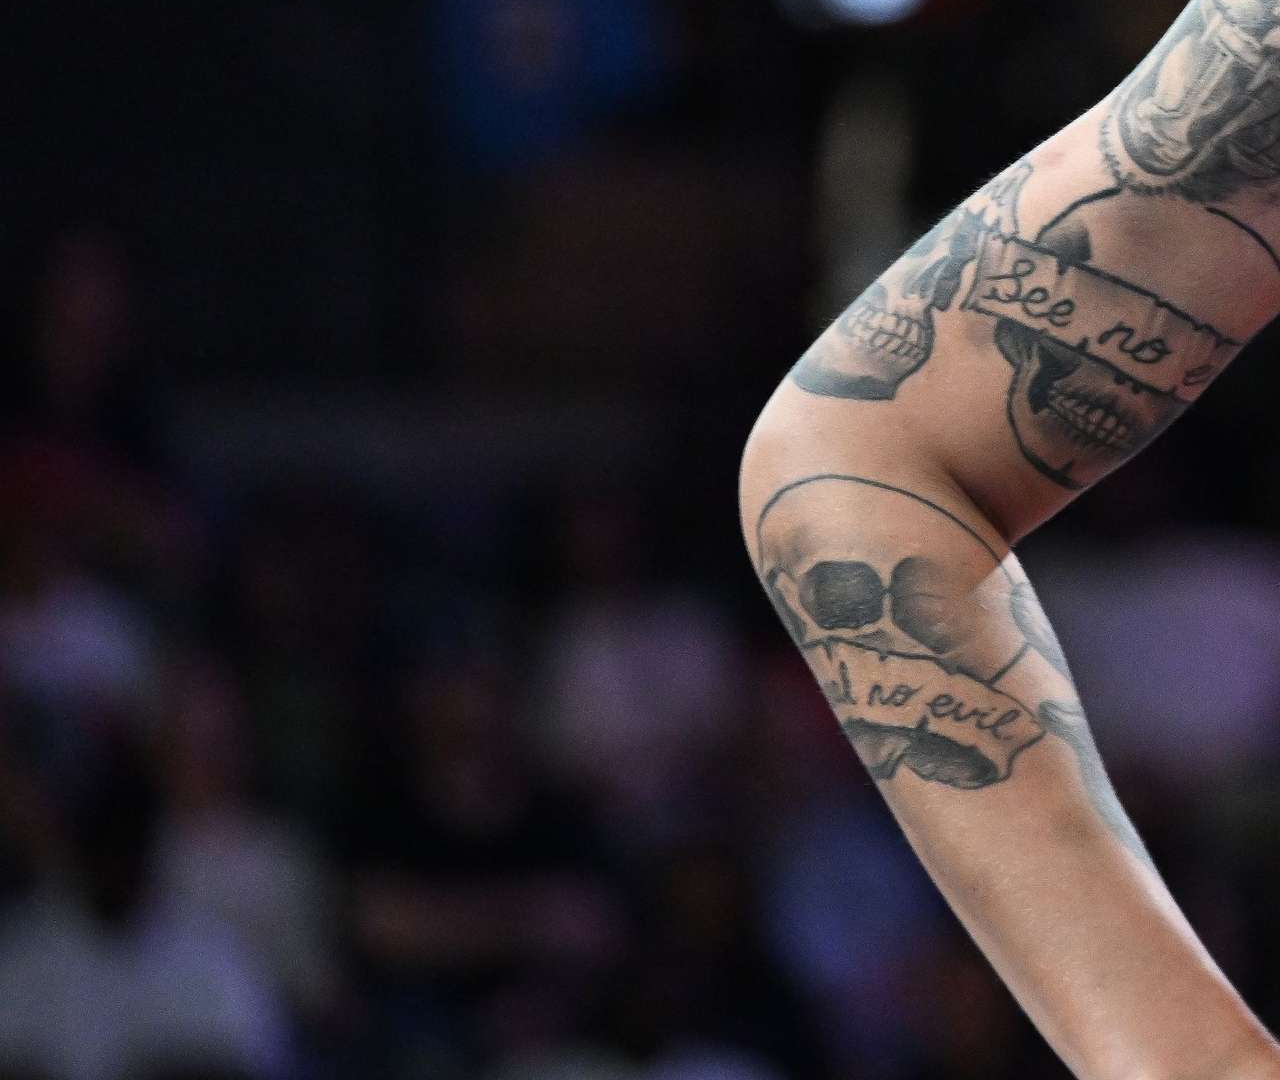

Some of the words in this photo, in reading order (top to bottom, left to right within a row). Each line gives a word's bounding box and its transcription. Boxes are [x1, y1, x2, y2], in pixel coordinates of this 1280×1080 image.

[984, 259, 1074, 327] See
[1098, 325, 1173, 364] no
[867, 684, 922, 707] no
[926, 693, 1021, 739] evil
